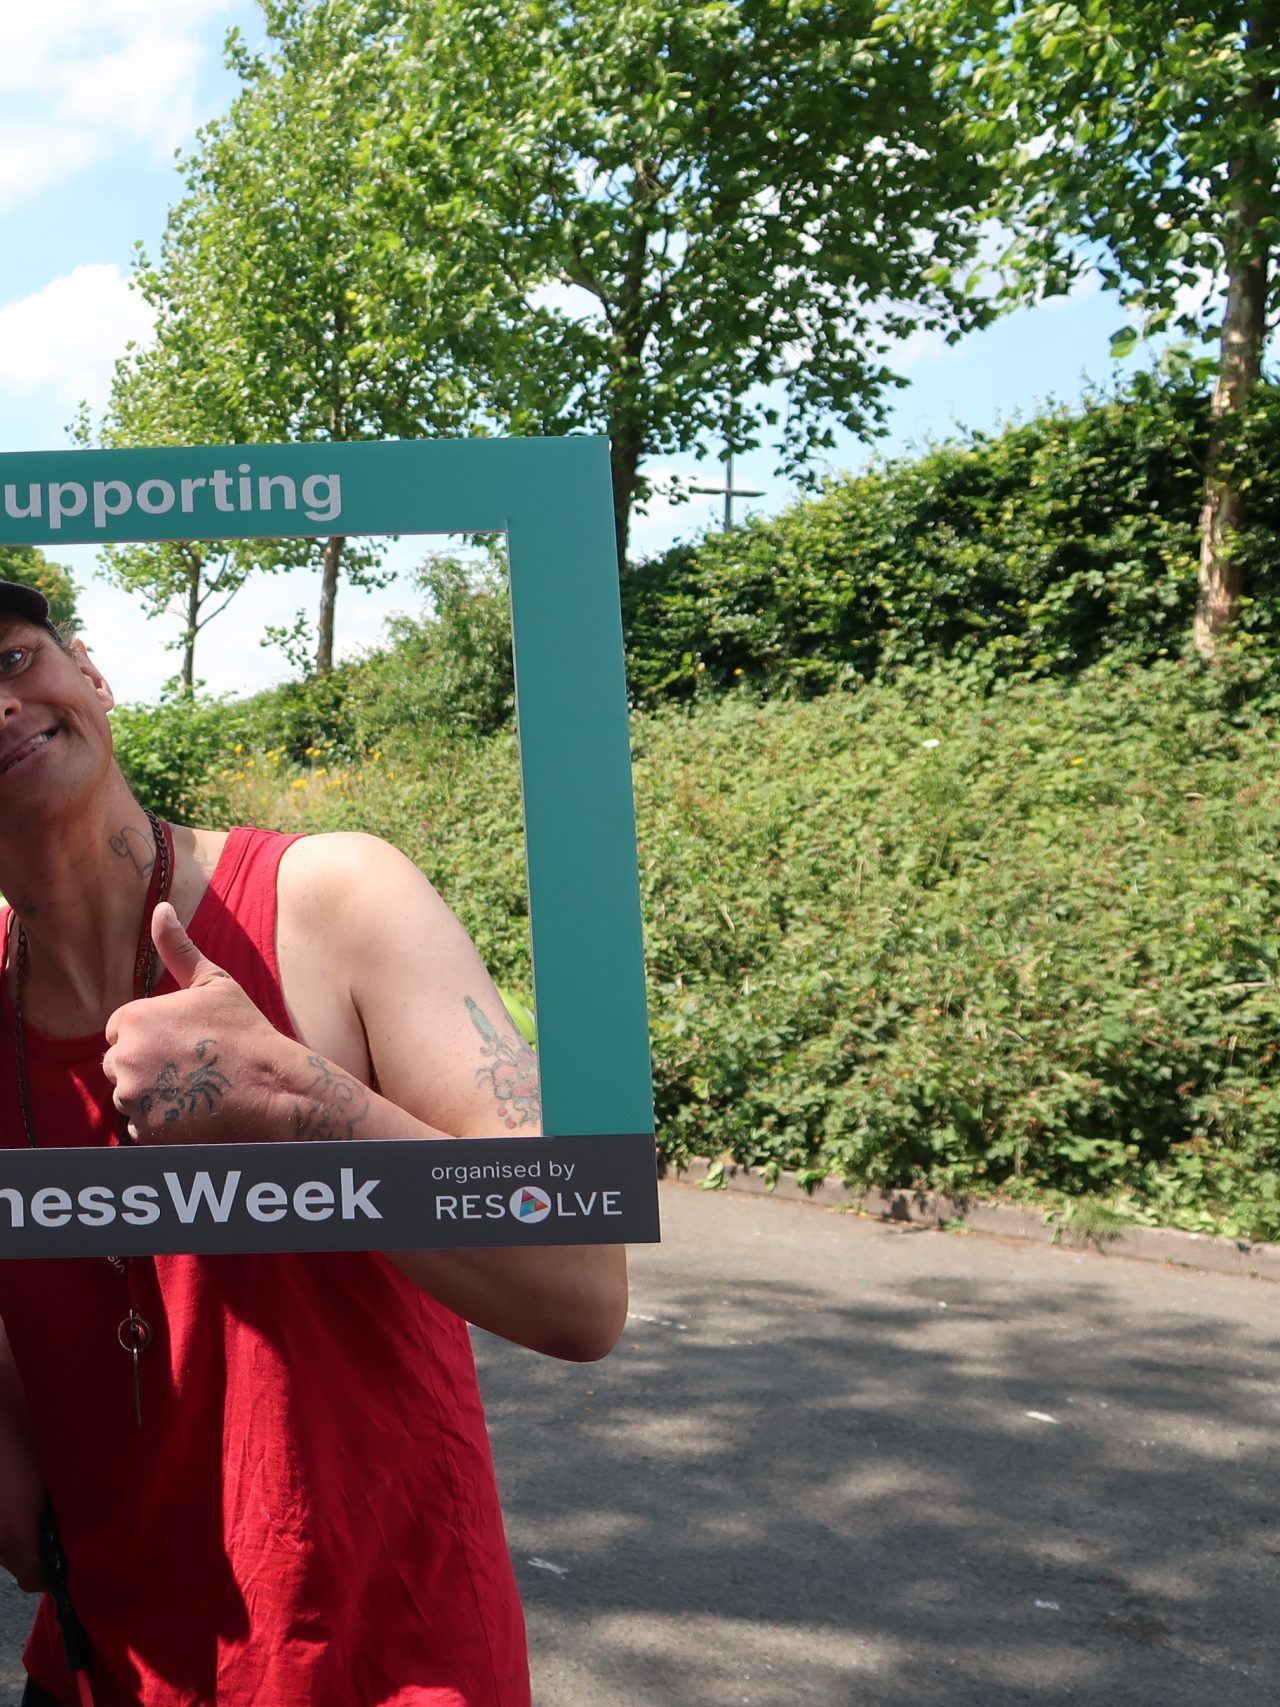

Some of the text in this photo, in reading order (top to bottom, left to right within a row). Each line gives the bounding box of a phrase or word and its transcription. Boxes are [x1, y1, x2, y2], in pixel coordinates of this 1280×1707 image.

[431, 1160, 575, 1184] organised by
[435, 1185, 623, 1224] RESOLVE
